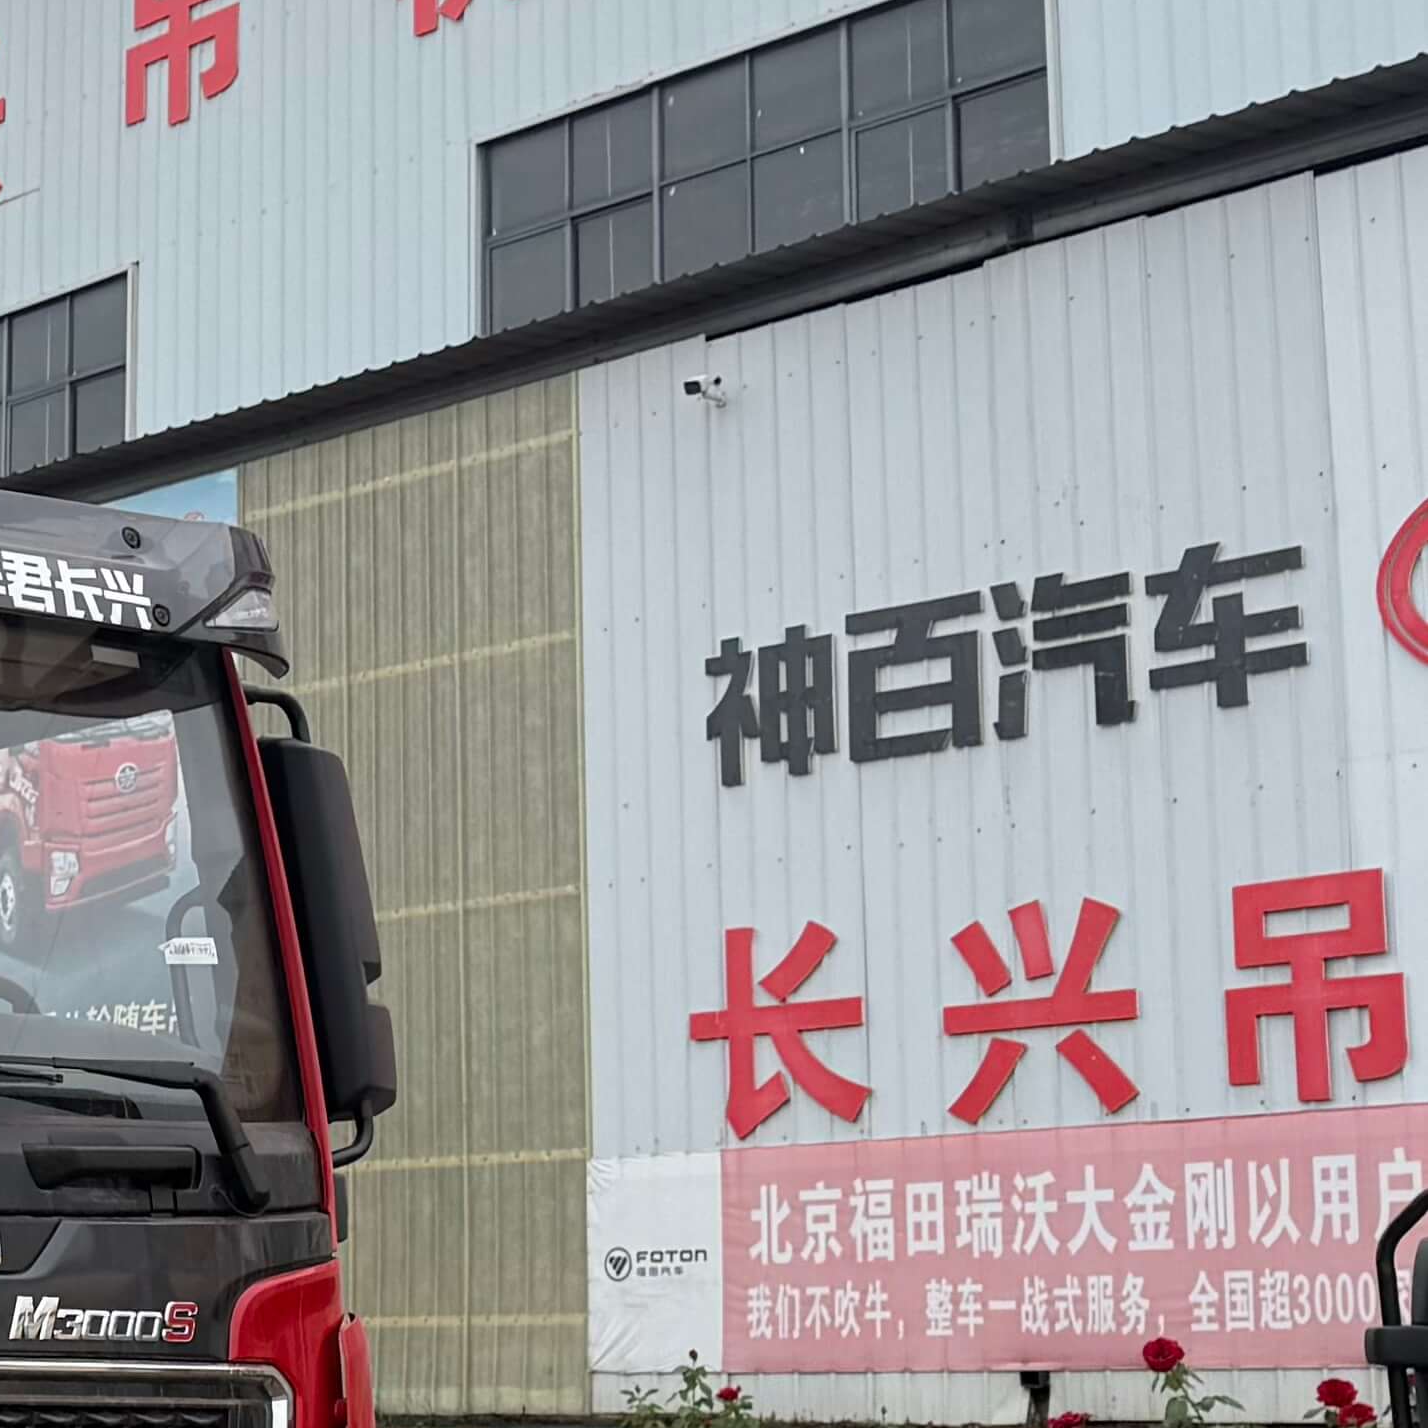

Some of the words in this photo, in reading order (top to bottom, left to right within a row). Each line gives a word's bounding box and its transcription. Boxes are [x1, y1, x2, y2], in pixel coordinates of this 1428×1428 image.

[706, 541, 1310, 787] 神百汽车
[689, 868, 1409, 1140] 长兴吊
[636, 1249, 708, 1263] FOTON
[749, 1147, 1424, 1266] 北京福田瑞沃大金刚以用户
[9, 1295, 200, 1344] M3000S
